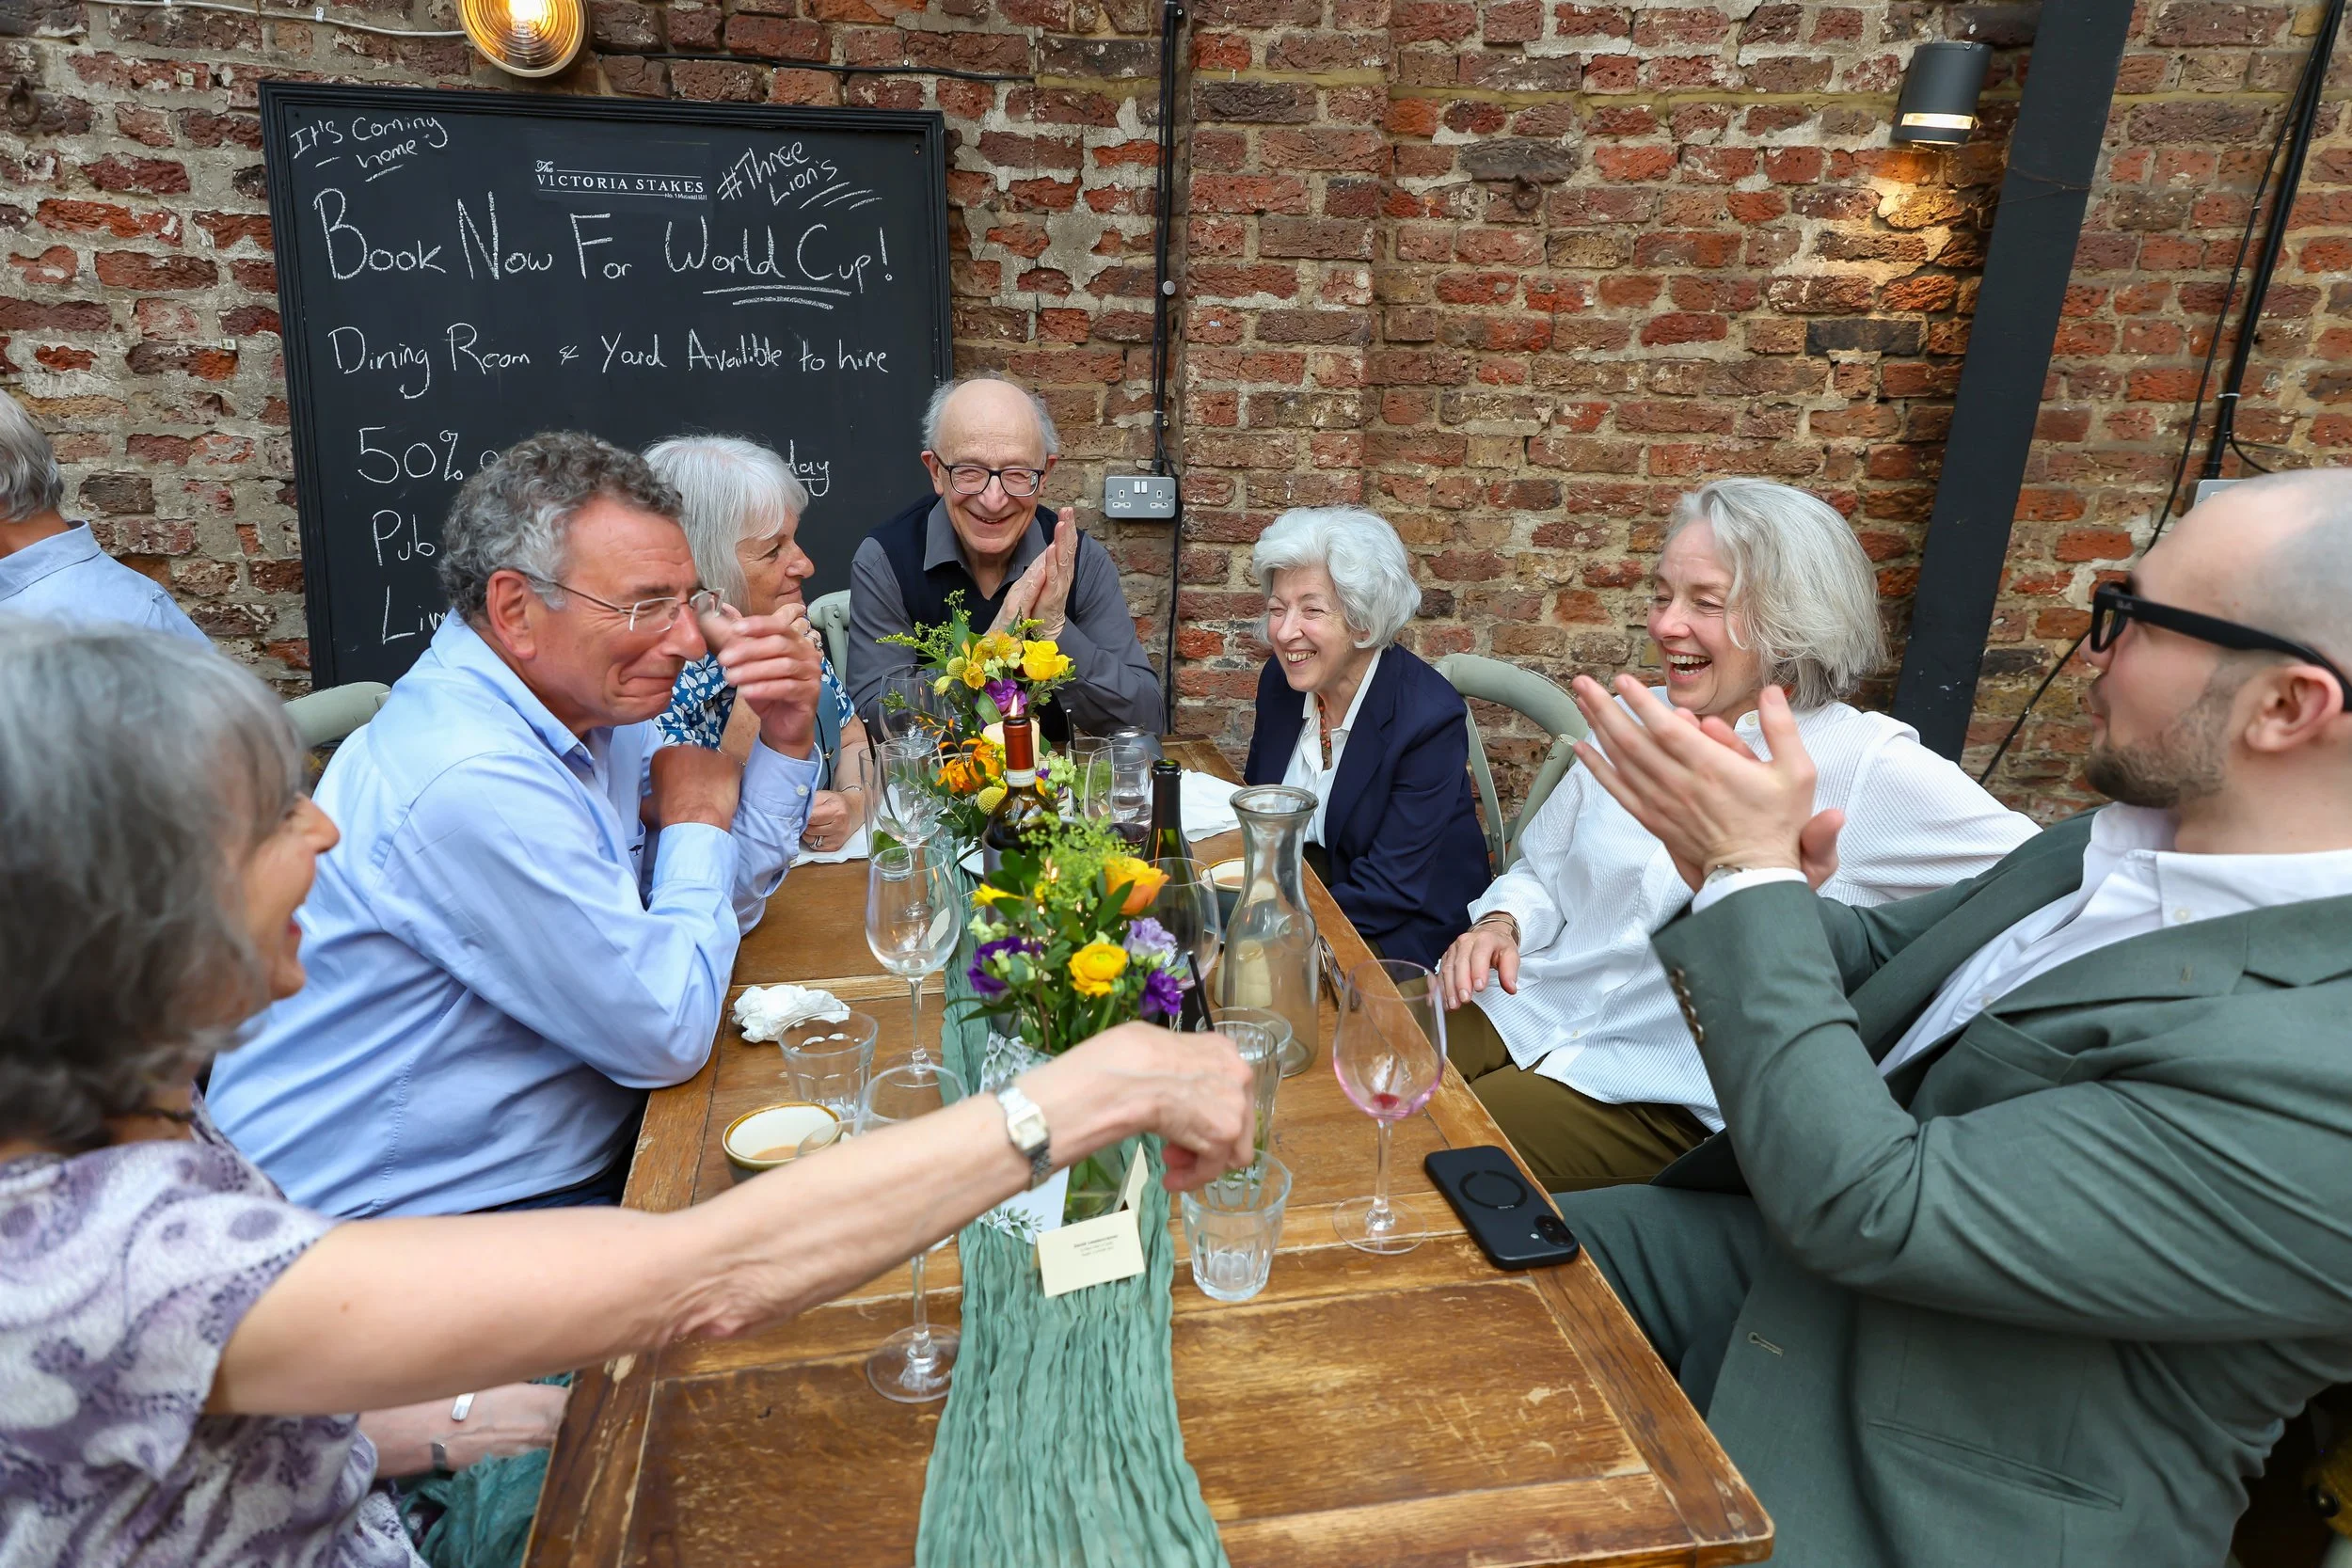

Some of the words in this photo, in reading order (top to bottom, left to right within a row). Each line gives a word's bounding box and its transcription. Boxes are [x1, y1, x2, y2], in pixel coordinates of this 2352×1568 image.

[290, 119, 343, 159] It's
[351, 116, 449, 148] Coming
[534, 159, 554, 173] The
[536, 174, 628, 190] VICTORIA
[635, 179, 704, 193] STAKES
[716, 141, 811, 200] #Three
[313, 188, 447, 280] Book
[457, 191, 553, 280] Now
[568, 213, 633, 280] For
[664, 215, 787, 279] World
[796, 223, 894, 294] Cup!
[327, 325, 432, 399] Dining
[600, 331, 668, 373] Yard
[798, 338, 826, 372] to
[838, 338, 889, 372] hire
[357, 425, 464, 484] 50%
[372, 509, 436, 566] Pub
